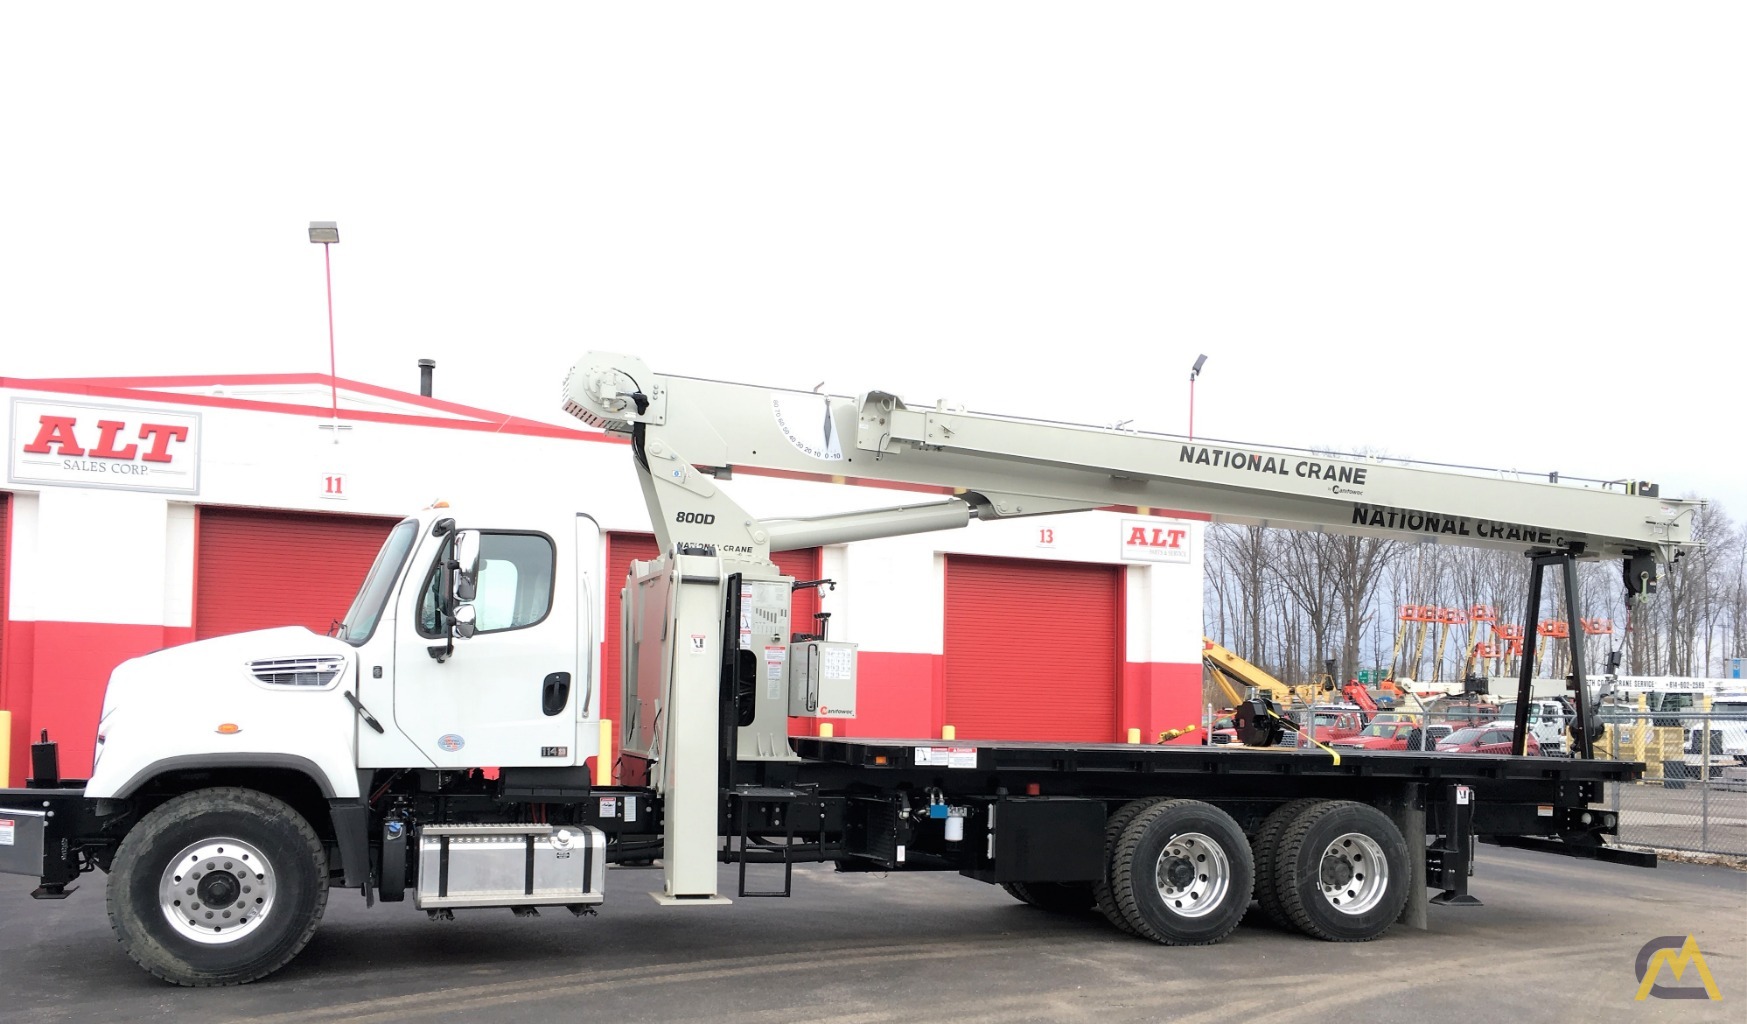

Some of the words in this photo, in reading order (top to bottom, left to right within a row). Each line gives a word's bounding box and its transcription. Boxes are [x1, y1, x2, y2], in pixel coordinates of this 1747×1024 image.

[23, 415, 189, 464] ALT
[789, 435, 796, 443] 40
[796, 441, 804, 449] 30
[804, 446, 812, 454] 20
[63, 459, 107, 473] SALES
[1179, 445, 1290, 476] NATIONAL
[1295, 461, 1367, 486] CRANE
[325, 475, 343, 494] 11
[676, 511, 715, 525] 800D
[1352, 506, 1470, 536] NATIONAL
[1476, 522, 1552, 544] CRANE
[1039, 529, 1054, 544] 13
[1126, 527, 1186, 549] ALT
[723, 545, 754, 553] CRANE
[1634, 680, 1655, 688] SERVICE
